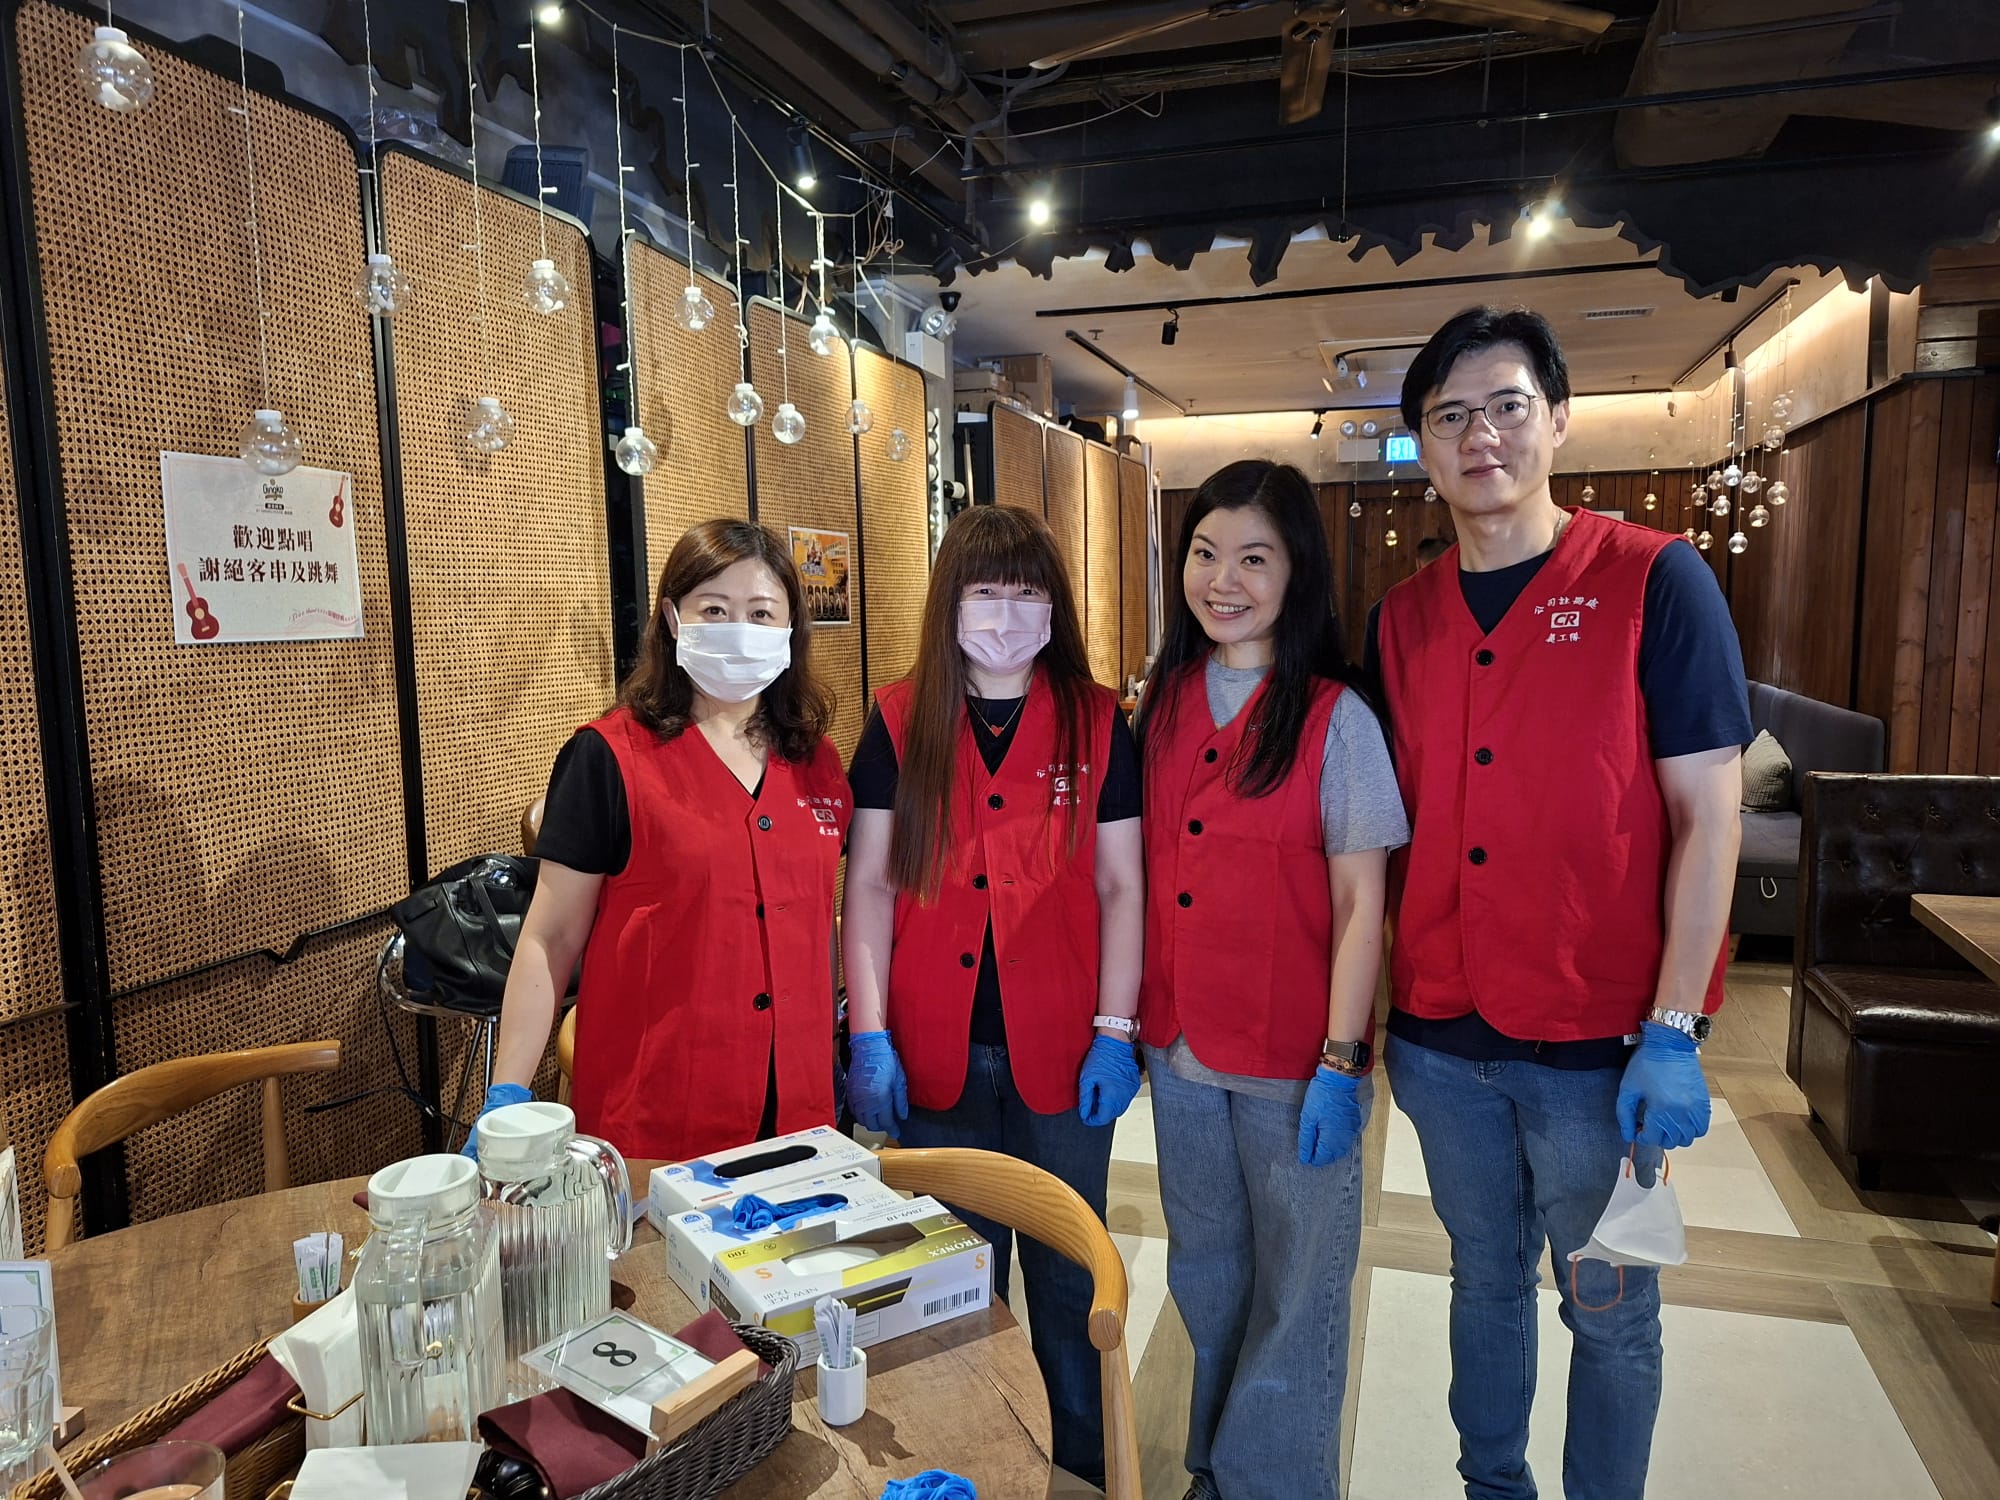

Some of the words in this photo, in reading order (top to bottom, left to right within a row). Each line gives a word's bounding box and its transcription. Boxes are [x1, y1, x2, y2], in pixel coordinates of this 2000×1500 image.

[1391, 440, 1417, 459] EXI
[232, 524, 314, 553] 歡迎點唱
[199, 557, 339, 584] 謝絕客串及跳舞
[1553, 612, 1578, 627] CR
[928, 1237, 983, 1258] TRONEX
[975, 1253, 985, 1270] S
[754, 1268, 774, 1279] S
[592, 1341, 637, 1367] 8
